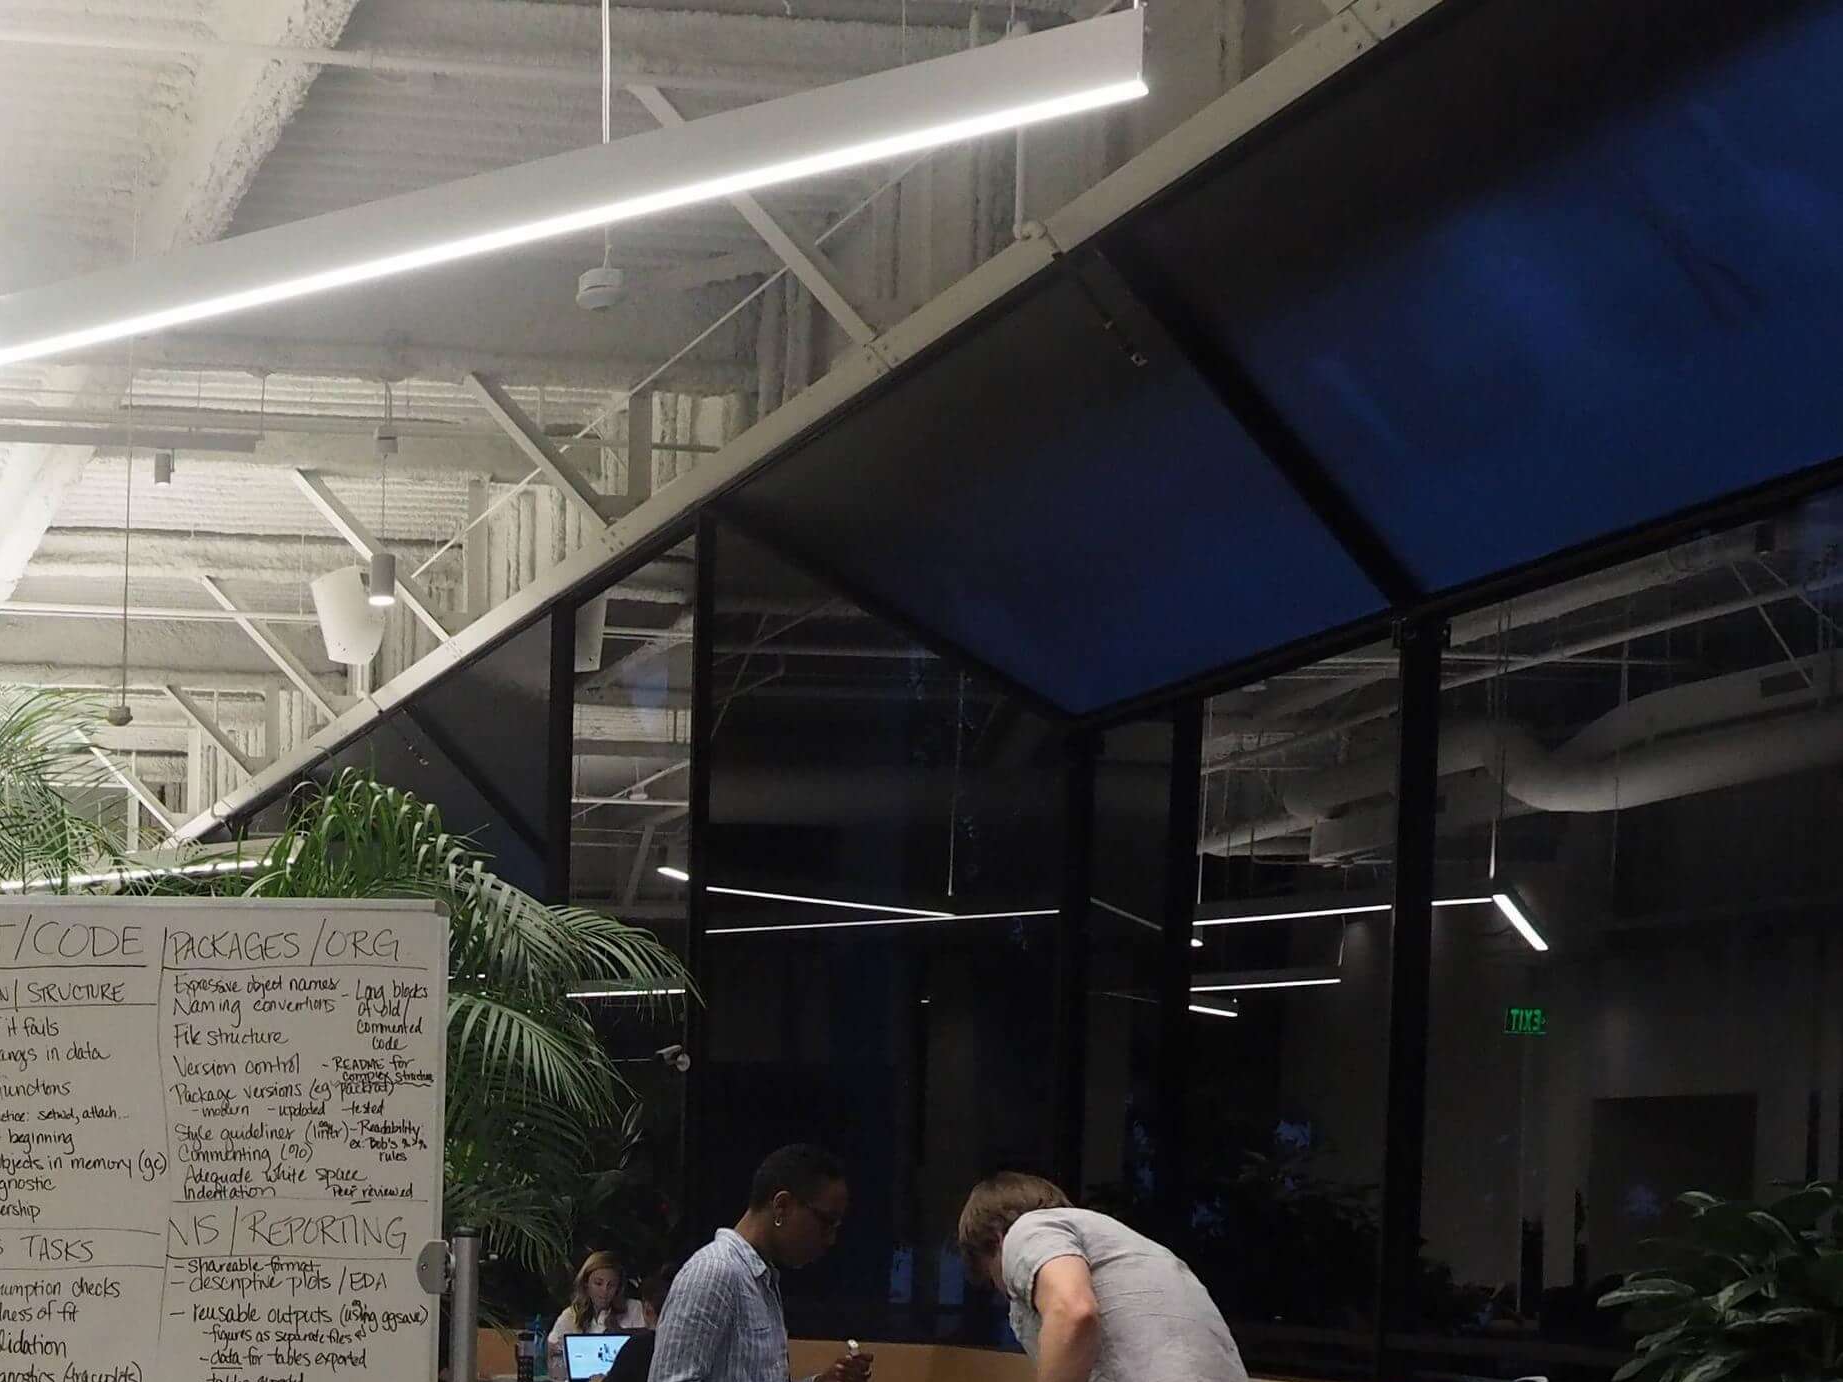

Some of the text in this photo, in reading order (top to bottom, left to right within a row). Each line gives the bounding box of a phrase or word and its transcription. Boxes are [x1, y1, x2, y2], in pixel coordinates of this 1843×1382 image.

[168, 919, 399, 967] PACKAGES/ORG
[27, 982, 125, 1003] STRUCTURE
[247, 976, 282, 999] object
[20, 1017, 59, 1039] fails
[207, 1027, 289, 1046] structure
[47, 1044, 60, 1061] in
[66, 1041, 110, 1061] data
[372, 1037, 408, 1052] code
[173, 1053, 300, 1077] Version control
[393, 1055, 415, 1071] for
[279, 1102, 325, 1121] updated
[9, 1128, 75, 1155] beginning
[48, 1153, 62, 1169] in
[71, 1157, 133, 1178] memory
[362, 1182, 413, 1199] reviewed
[20, 1234, 95, 1263] TASKS
[72, 1277, 120, 1298] checks
[189, 1273, 332, 1299] descriptive plots
[37, 1300, 56, 1321] of
[58, 1302, 79, 1323] fit
[193, 1303, 261, 1323] reusable
[268, 1304, 333, 1334] outputs
[211, 1350, 242, 1367] data
[268, 1349, 310, 1367] tables
[315, 1349, 366, 1374] exported
